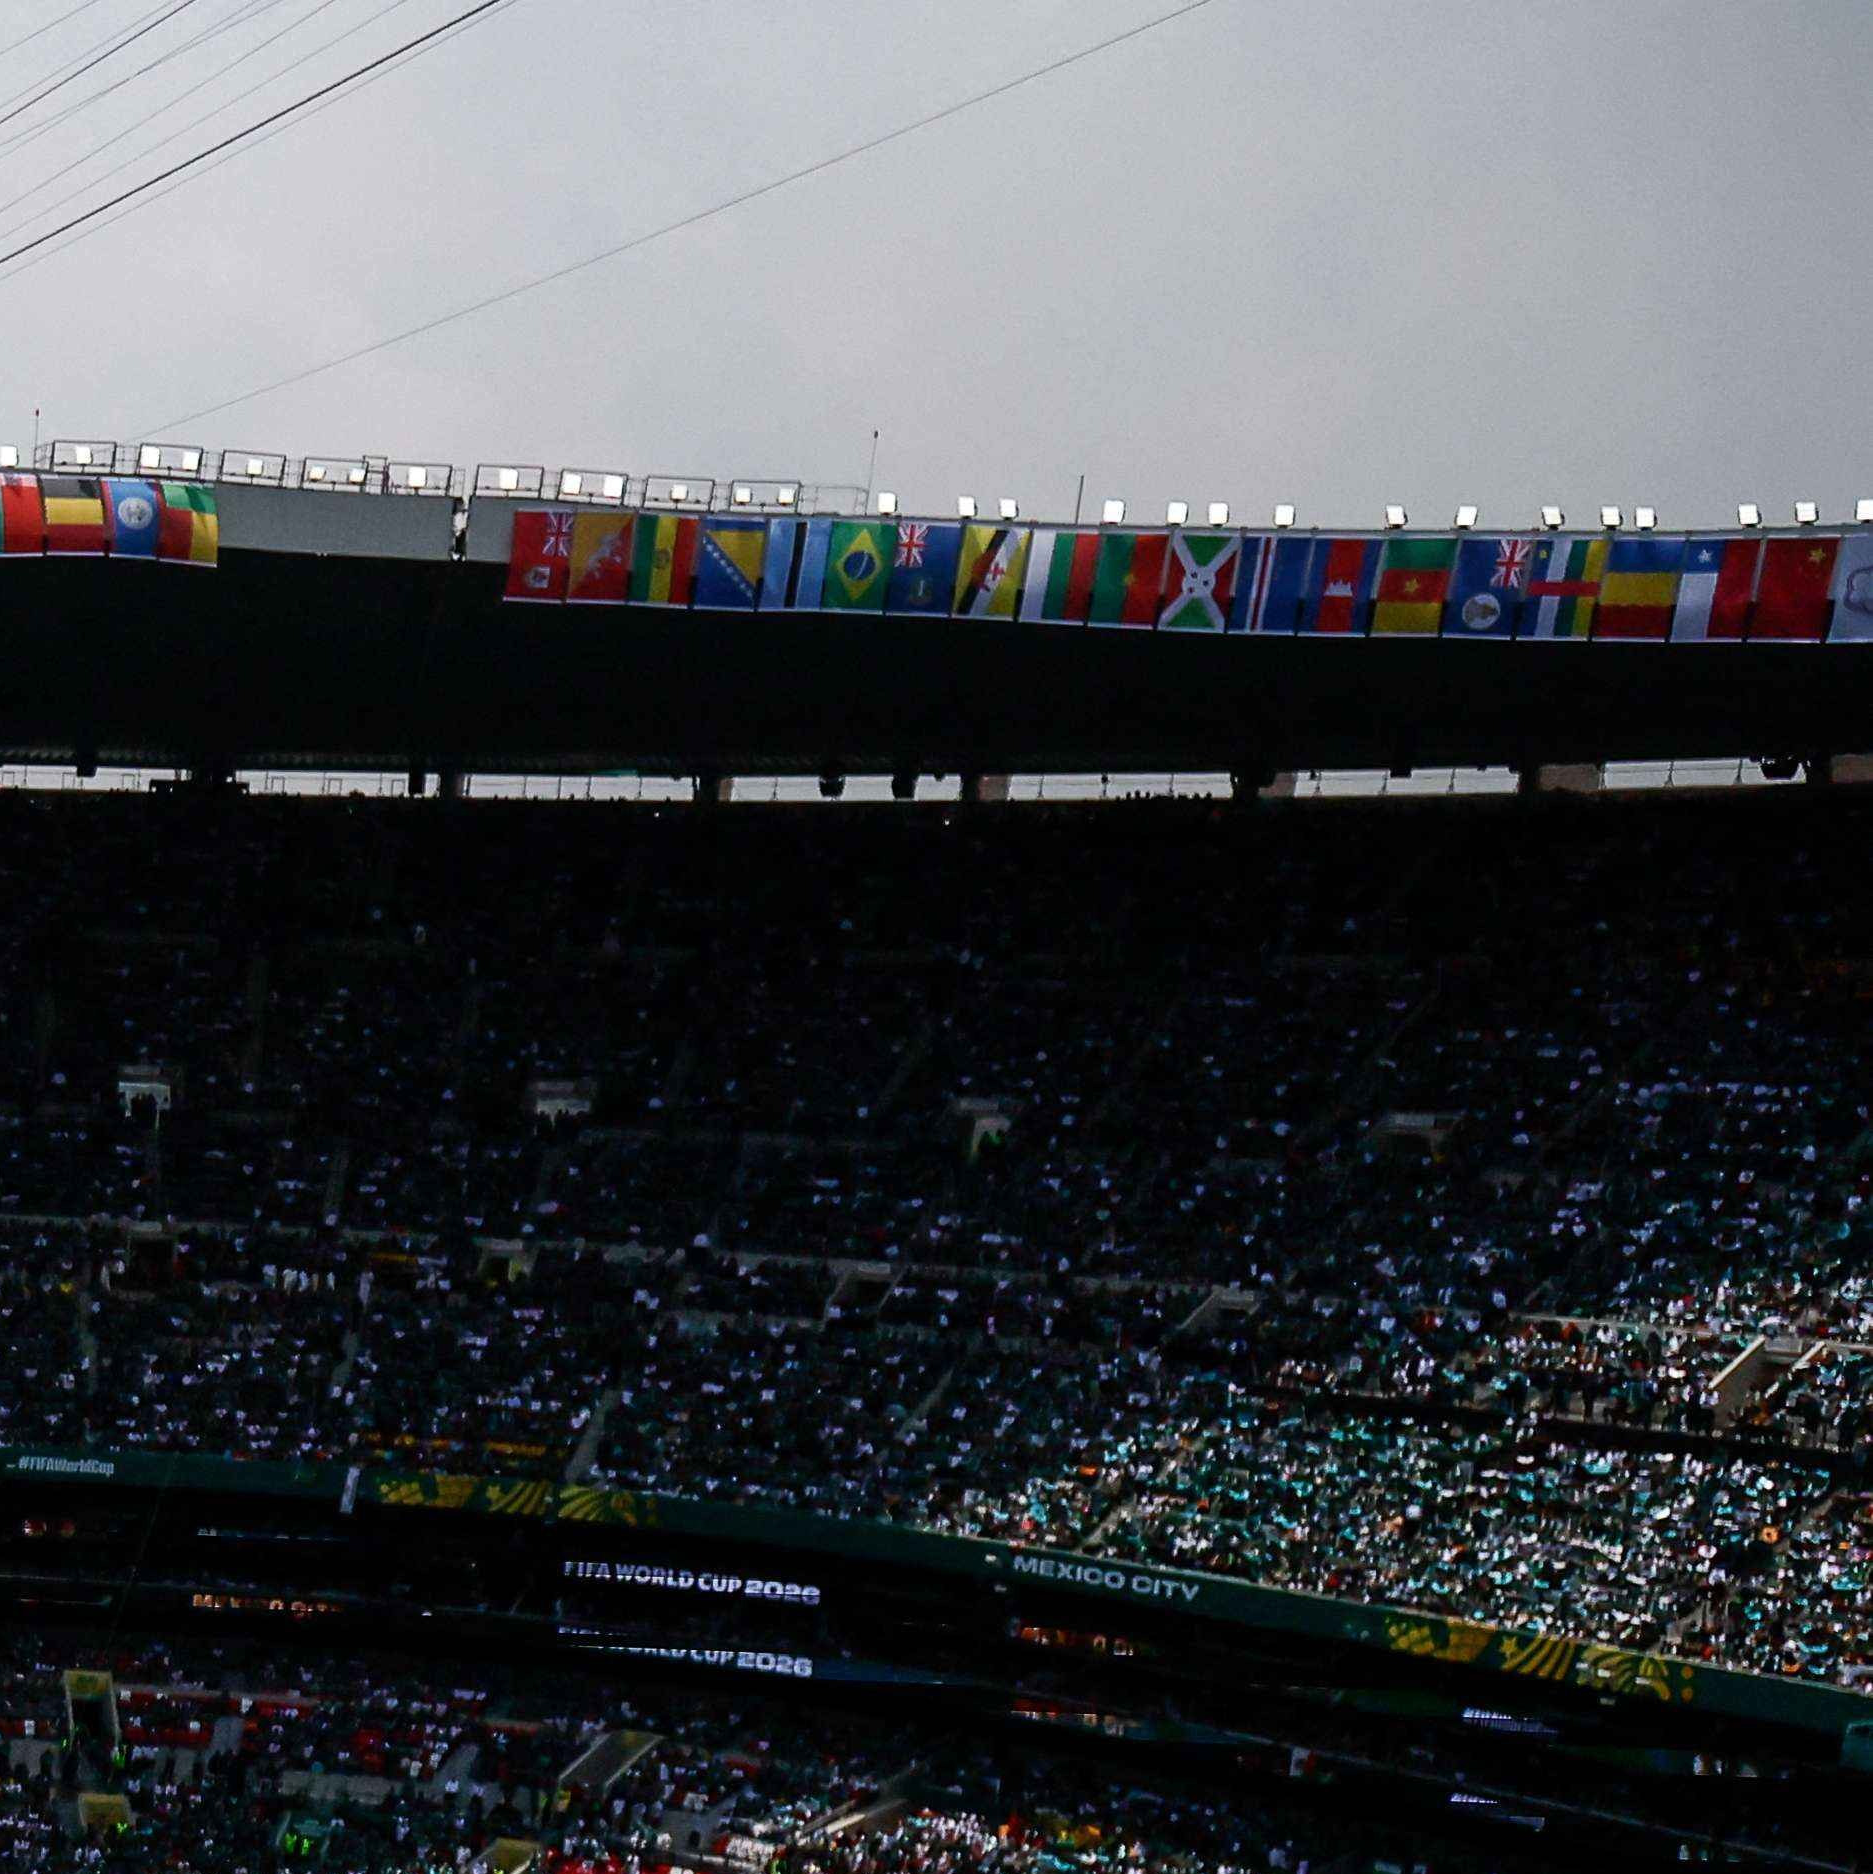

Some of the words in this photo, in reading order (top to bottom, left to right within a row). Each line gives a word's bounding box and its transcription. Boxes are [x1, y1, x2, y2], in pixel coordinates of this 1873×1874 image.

[564, 1561, 612, 1582] FIFA
[615, 1564, 694, 1590] WORLD
[698, 1572, 742, 1594] CUP
[744, 1579, 822, 1607] 2026
[1013, 1555, 1126, 1590] MEXICO
[1132, 1574, 1200, 1601] CITY
[737, 1651, 814, 1679] 2026
